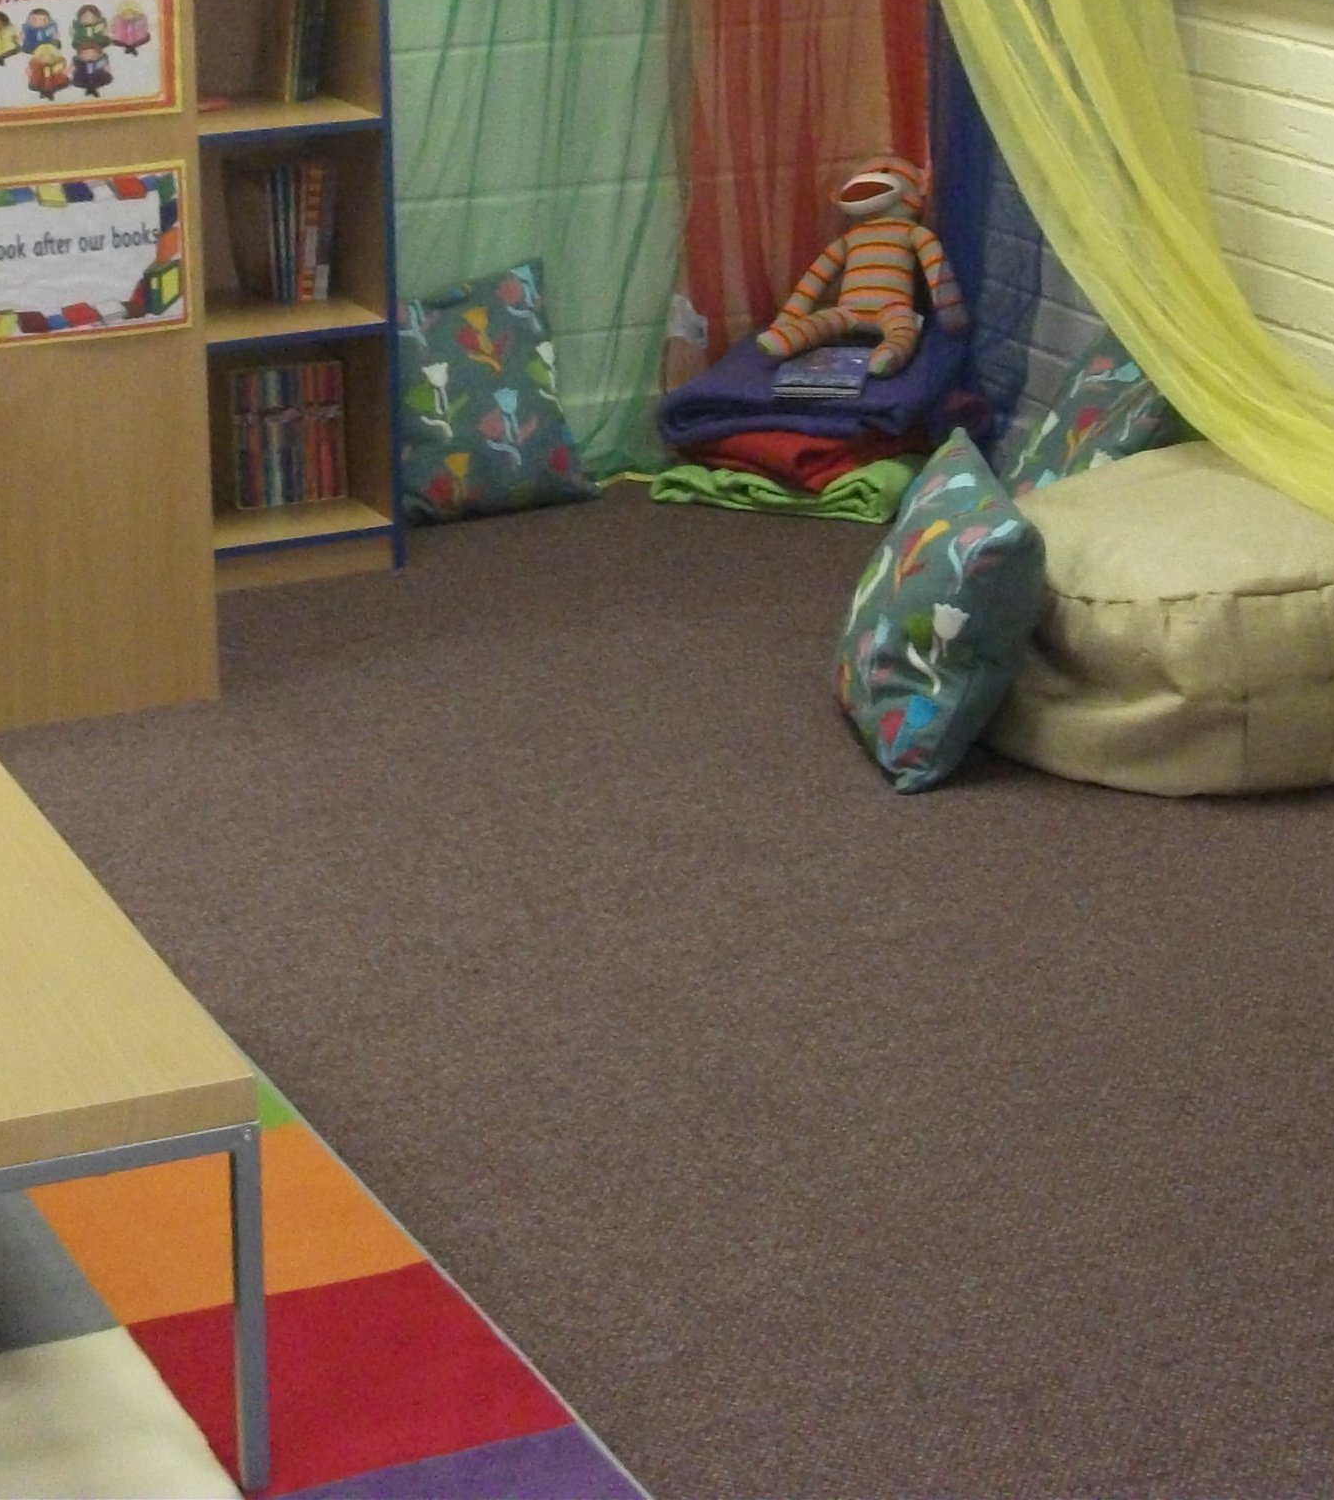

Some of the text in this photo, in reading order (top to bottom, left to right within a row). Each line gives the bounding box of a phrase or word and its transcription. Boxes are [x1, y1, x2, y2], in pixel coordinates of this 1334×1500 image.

[32, 231, 71, 257] after
[78, 234, 106, 252] our
[111, 221, 160, 249] books
